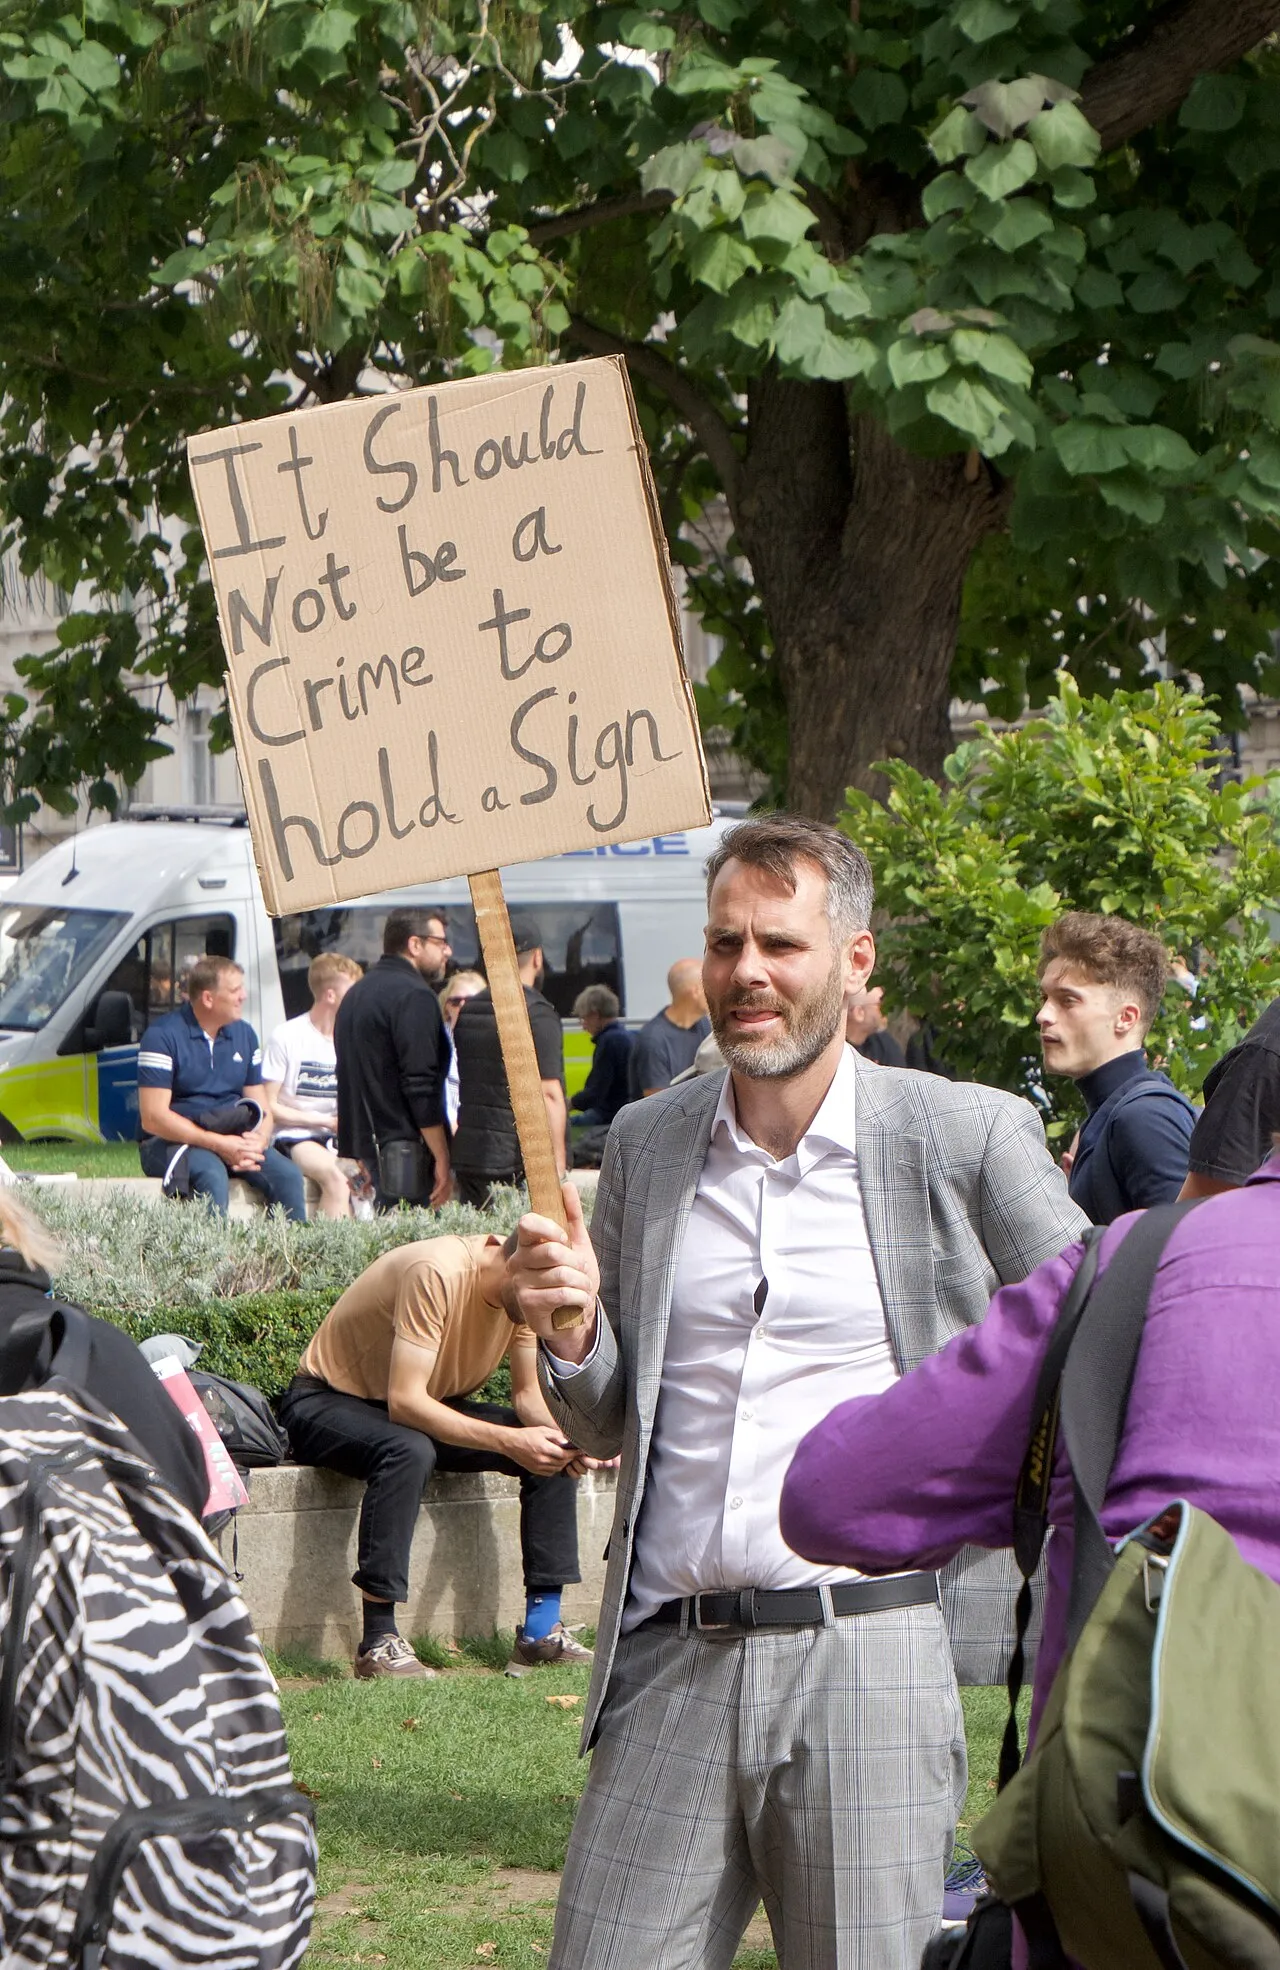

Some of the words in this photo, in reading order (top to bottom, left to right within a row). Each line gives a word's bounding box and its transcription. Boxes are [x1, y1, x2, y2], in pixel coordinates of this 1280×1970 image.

[191, 426, 329, 560] It
[363, 381, 604, 514] Should
[227, 552, 357, 656] Not
[398, 523, 467, 598] be
[512, 506, 563, 562] a
[246, 646, 434, 747] Crime
[478, 588, 573, 681] to
[258, 730, 464, 882] hold
[481, 786, 512, 813] a
[510, 687, 683, 833] Sign
